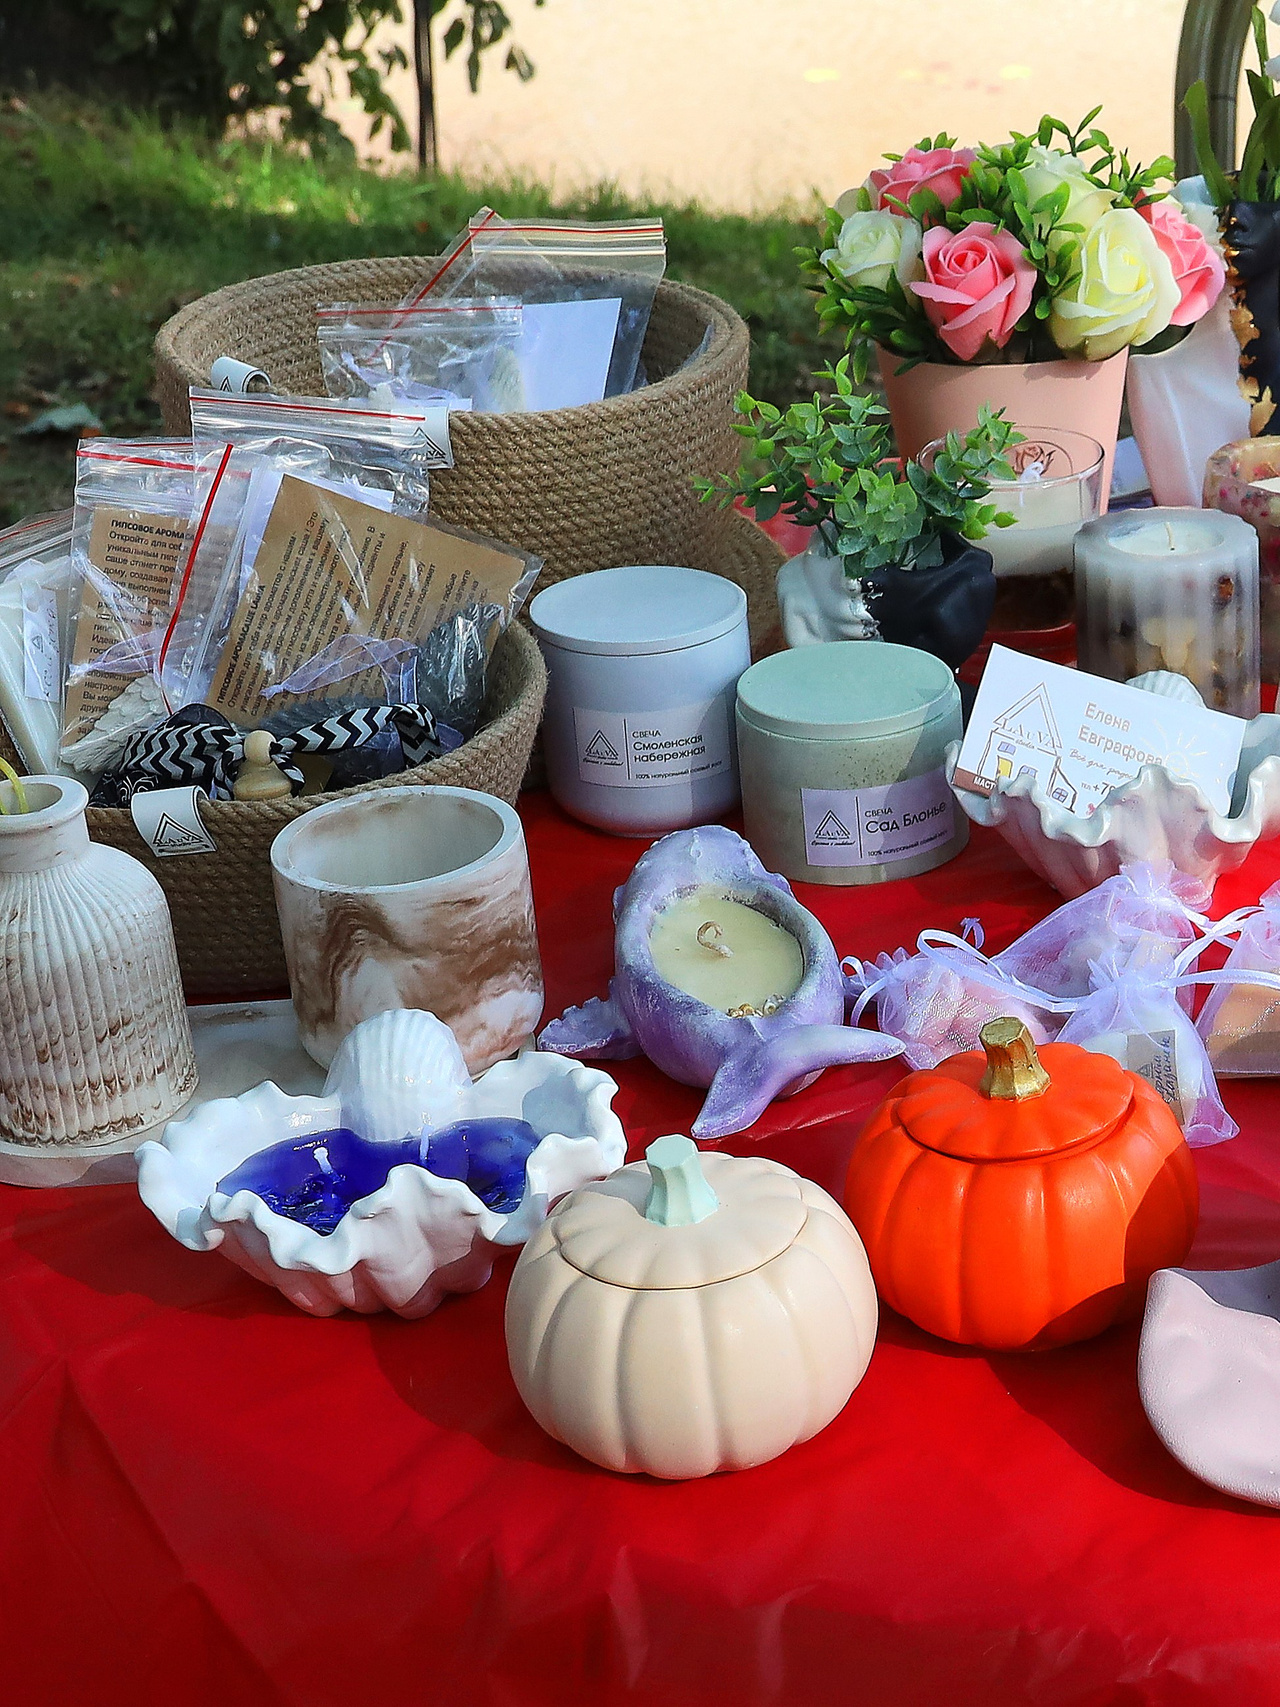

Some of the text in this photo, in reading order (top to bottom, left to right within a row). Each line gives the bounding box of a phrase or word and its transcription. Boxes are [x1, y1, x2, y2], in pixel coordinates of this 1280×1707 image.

[110, 519, 154, 534] ГИПСОВОЕ
[305, 510, 319, 528] Это
[216, 661, 237, 704] ГИПСОВОЕ
[230, 609, 256, 662] АРОМАСАШЕ
[1085, 702, 1131, 732] Елена
[632, 730, 661, 738] СВЕЧА
[633, 734, 703, 751] Смоленская
[634, 745, 706, 763] набережная
[865, 807, 893, 818] СВЕЧА
[865, 802, 947, 834] Сад Блонье
